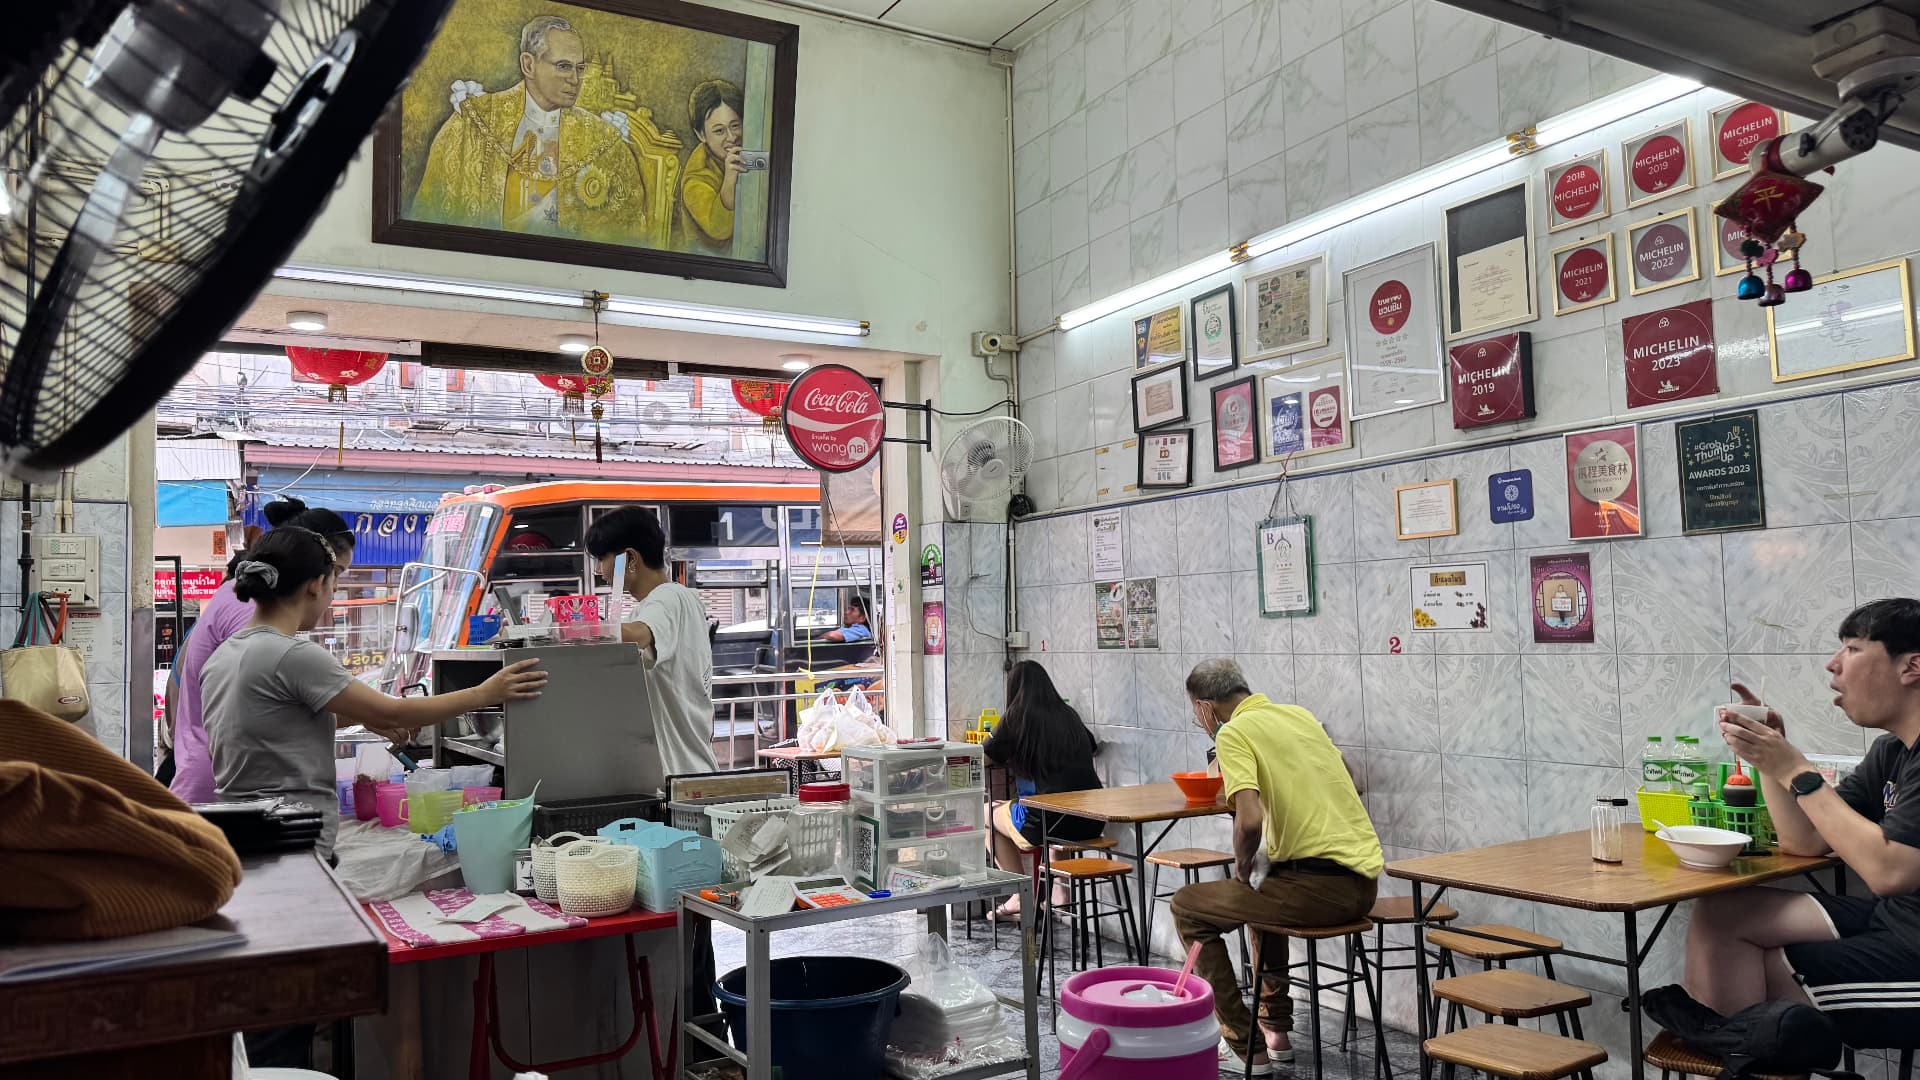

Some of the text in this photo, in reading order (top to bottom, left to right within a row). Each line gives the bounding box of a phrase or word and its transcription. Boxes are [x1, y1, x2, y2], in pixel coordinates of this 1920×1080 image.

[1723, 116, 1773, 140] MICHELIN
[1737, 133, 1759, 147] 2020
[1635, 146, 1680, 169] MICHELIN
[1647, 161, 1669, 176] 2019
[1566, 170, 1585, 183] 2018
[1554, 181, 1600, 202] MICHELIN
[1639, 242, 1684, 263] MICHELIN
[1563, 262, 1603, 280] MICHELIN
[1651, 256, 1674, 271] 2022
[1575, 276, 1592, 287] 2021
[1633, 335, 1700, 359] MICHELIN
[1651, 357, 1681, 371] 2023
[1458, 366, 1511, 385] MICHELIN
[1471, 383, 1495, 396] 2019
[804, 387, 871, 414] Coca-Cola
[811, 442, 866, 457] wongnai
[1721, 453, 1734, 464] Up
[1688, 464, 1751, 480] AWARDS 2023
[1266, 533, 1274, 545] B
[1041, 640, 1046, 652] 1
[1389, 636, 1402, 654] 2
